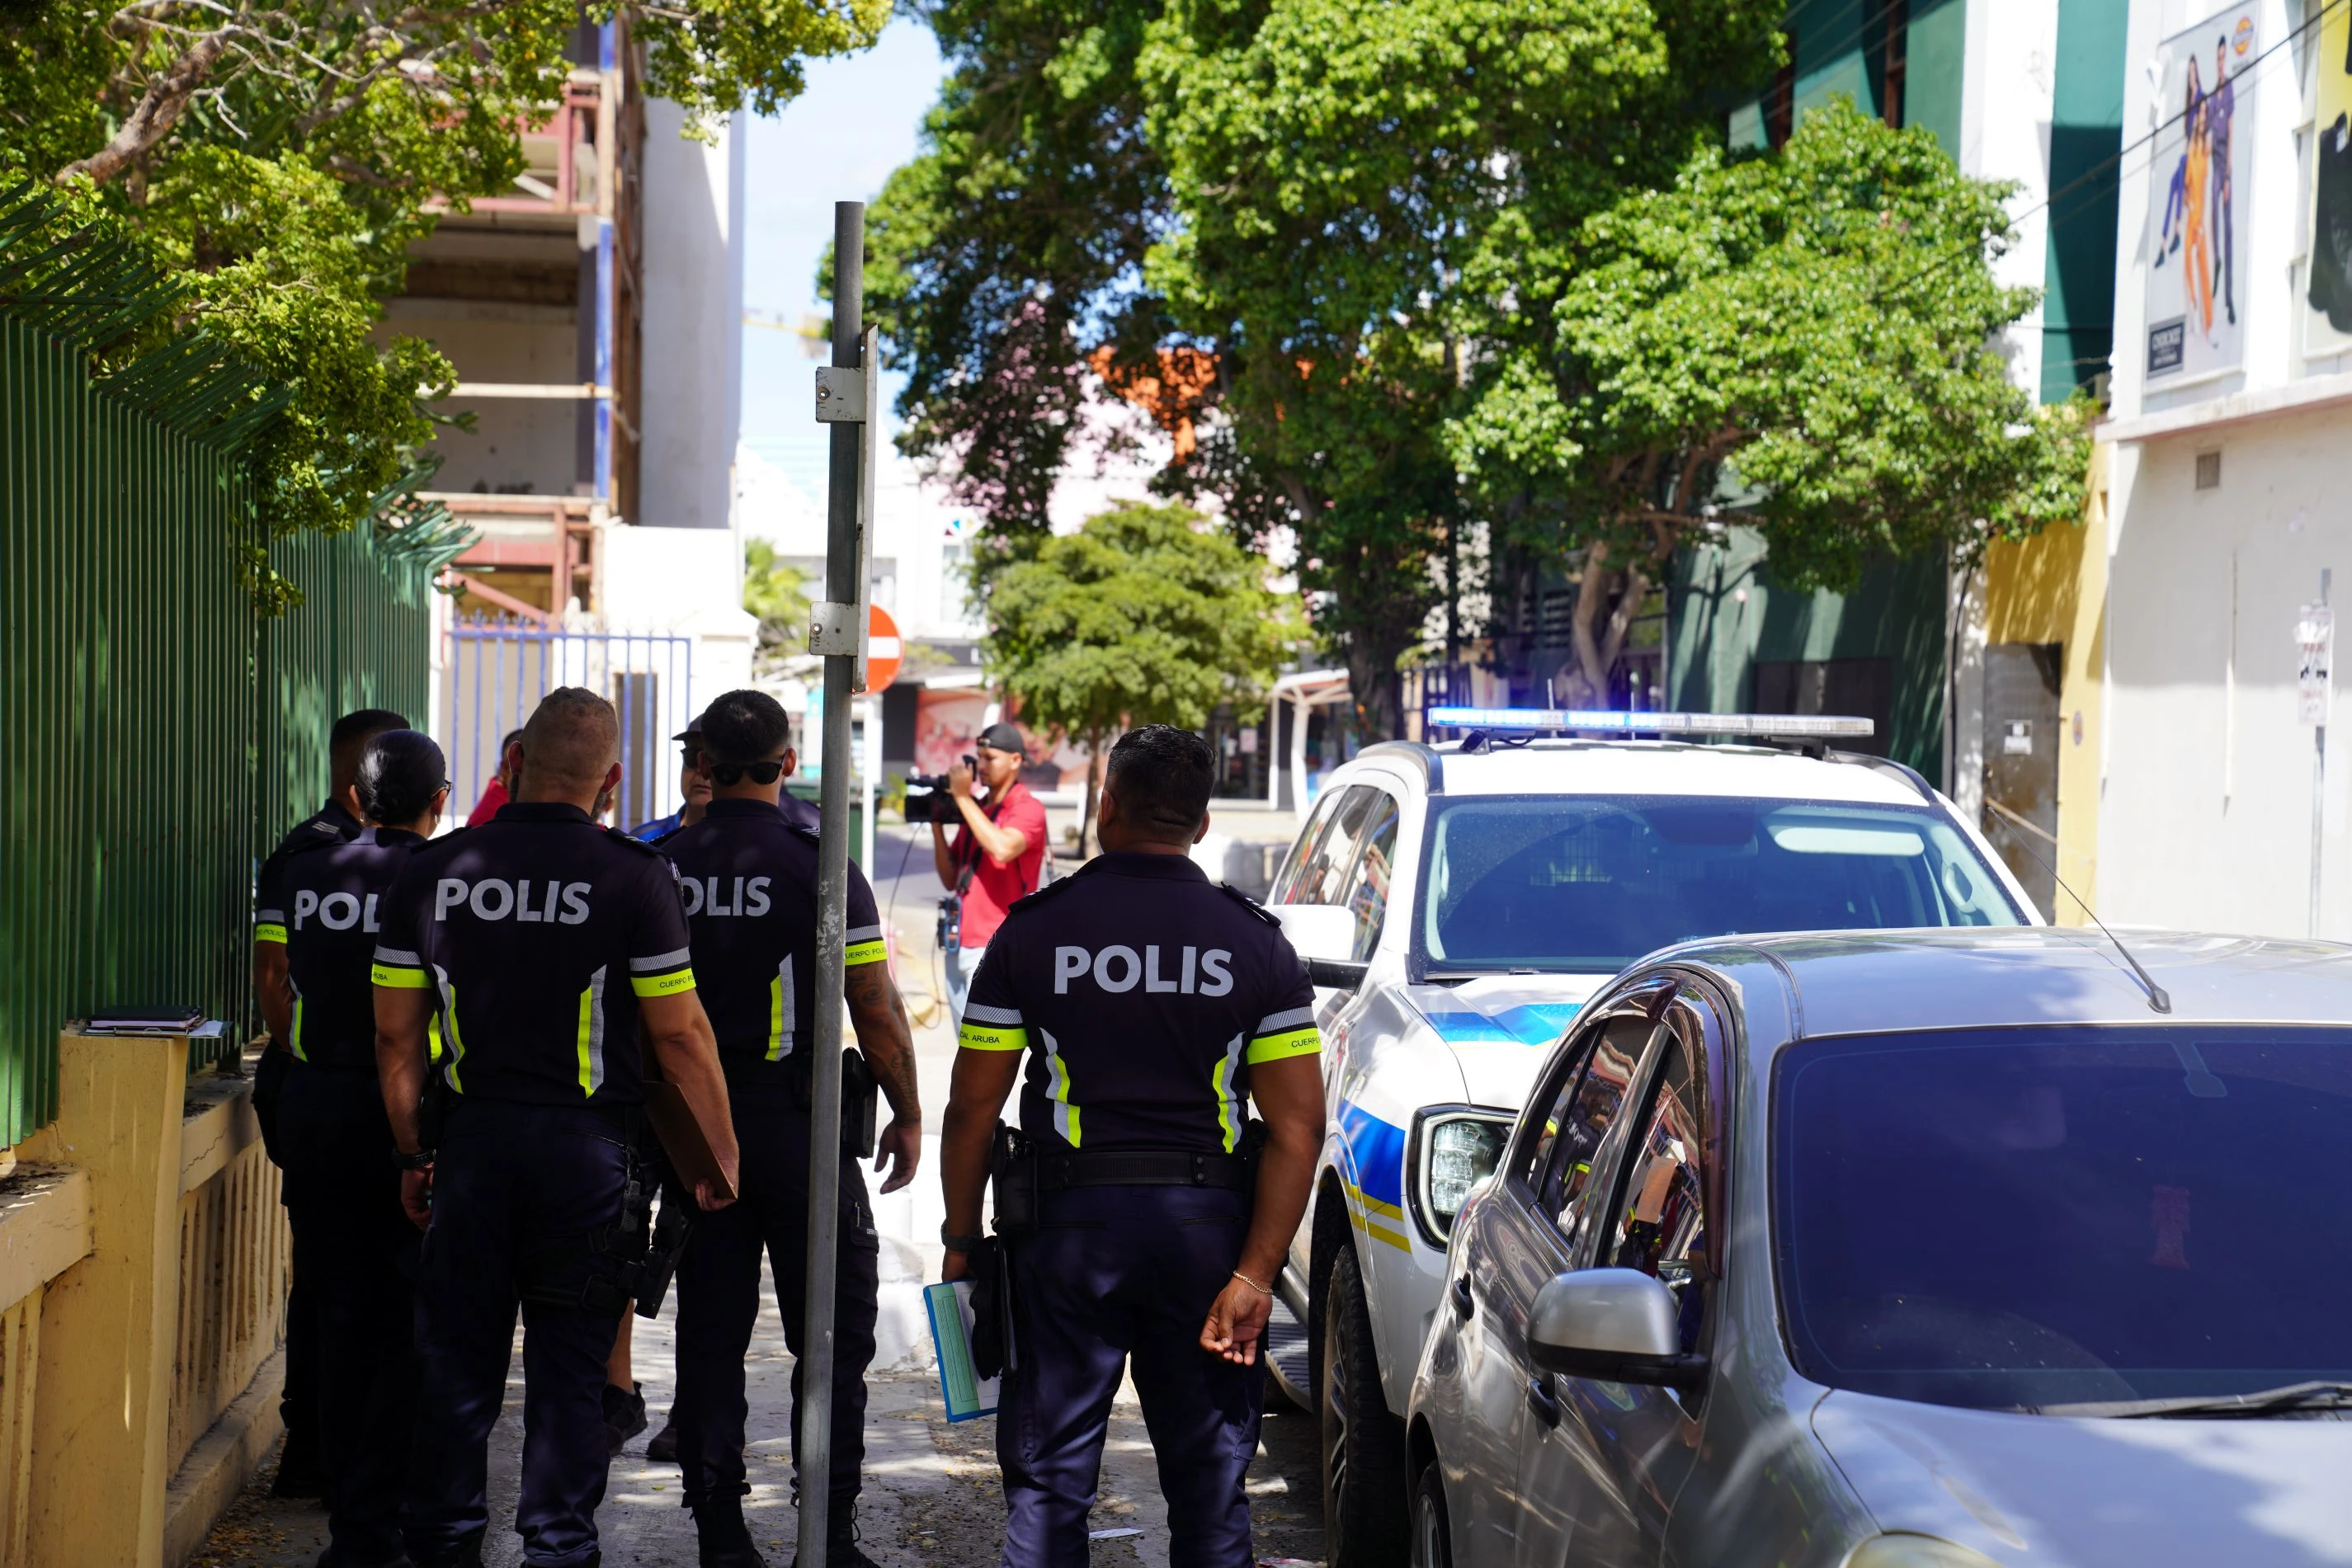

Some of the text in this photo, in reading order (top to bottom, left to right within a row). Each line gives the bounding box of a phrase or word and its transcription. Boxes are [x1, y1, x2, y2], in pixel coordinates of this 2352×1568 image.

[435, 878, 592, 925] POLIS
[681, 876, 771, 917] OLIS
[295, 889, 380, 933] POL
[845, 949, 870, 959] UERPO
[374, 972, 389, 982] RUBA
[659, 977, 687, 989] CUERPO
[1054, 944, 1234, 997] POLIS
[971, 1034, 1001, 1044] ARUBA
